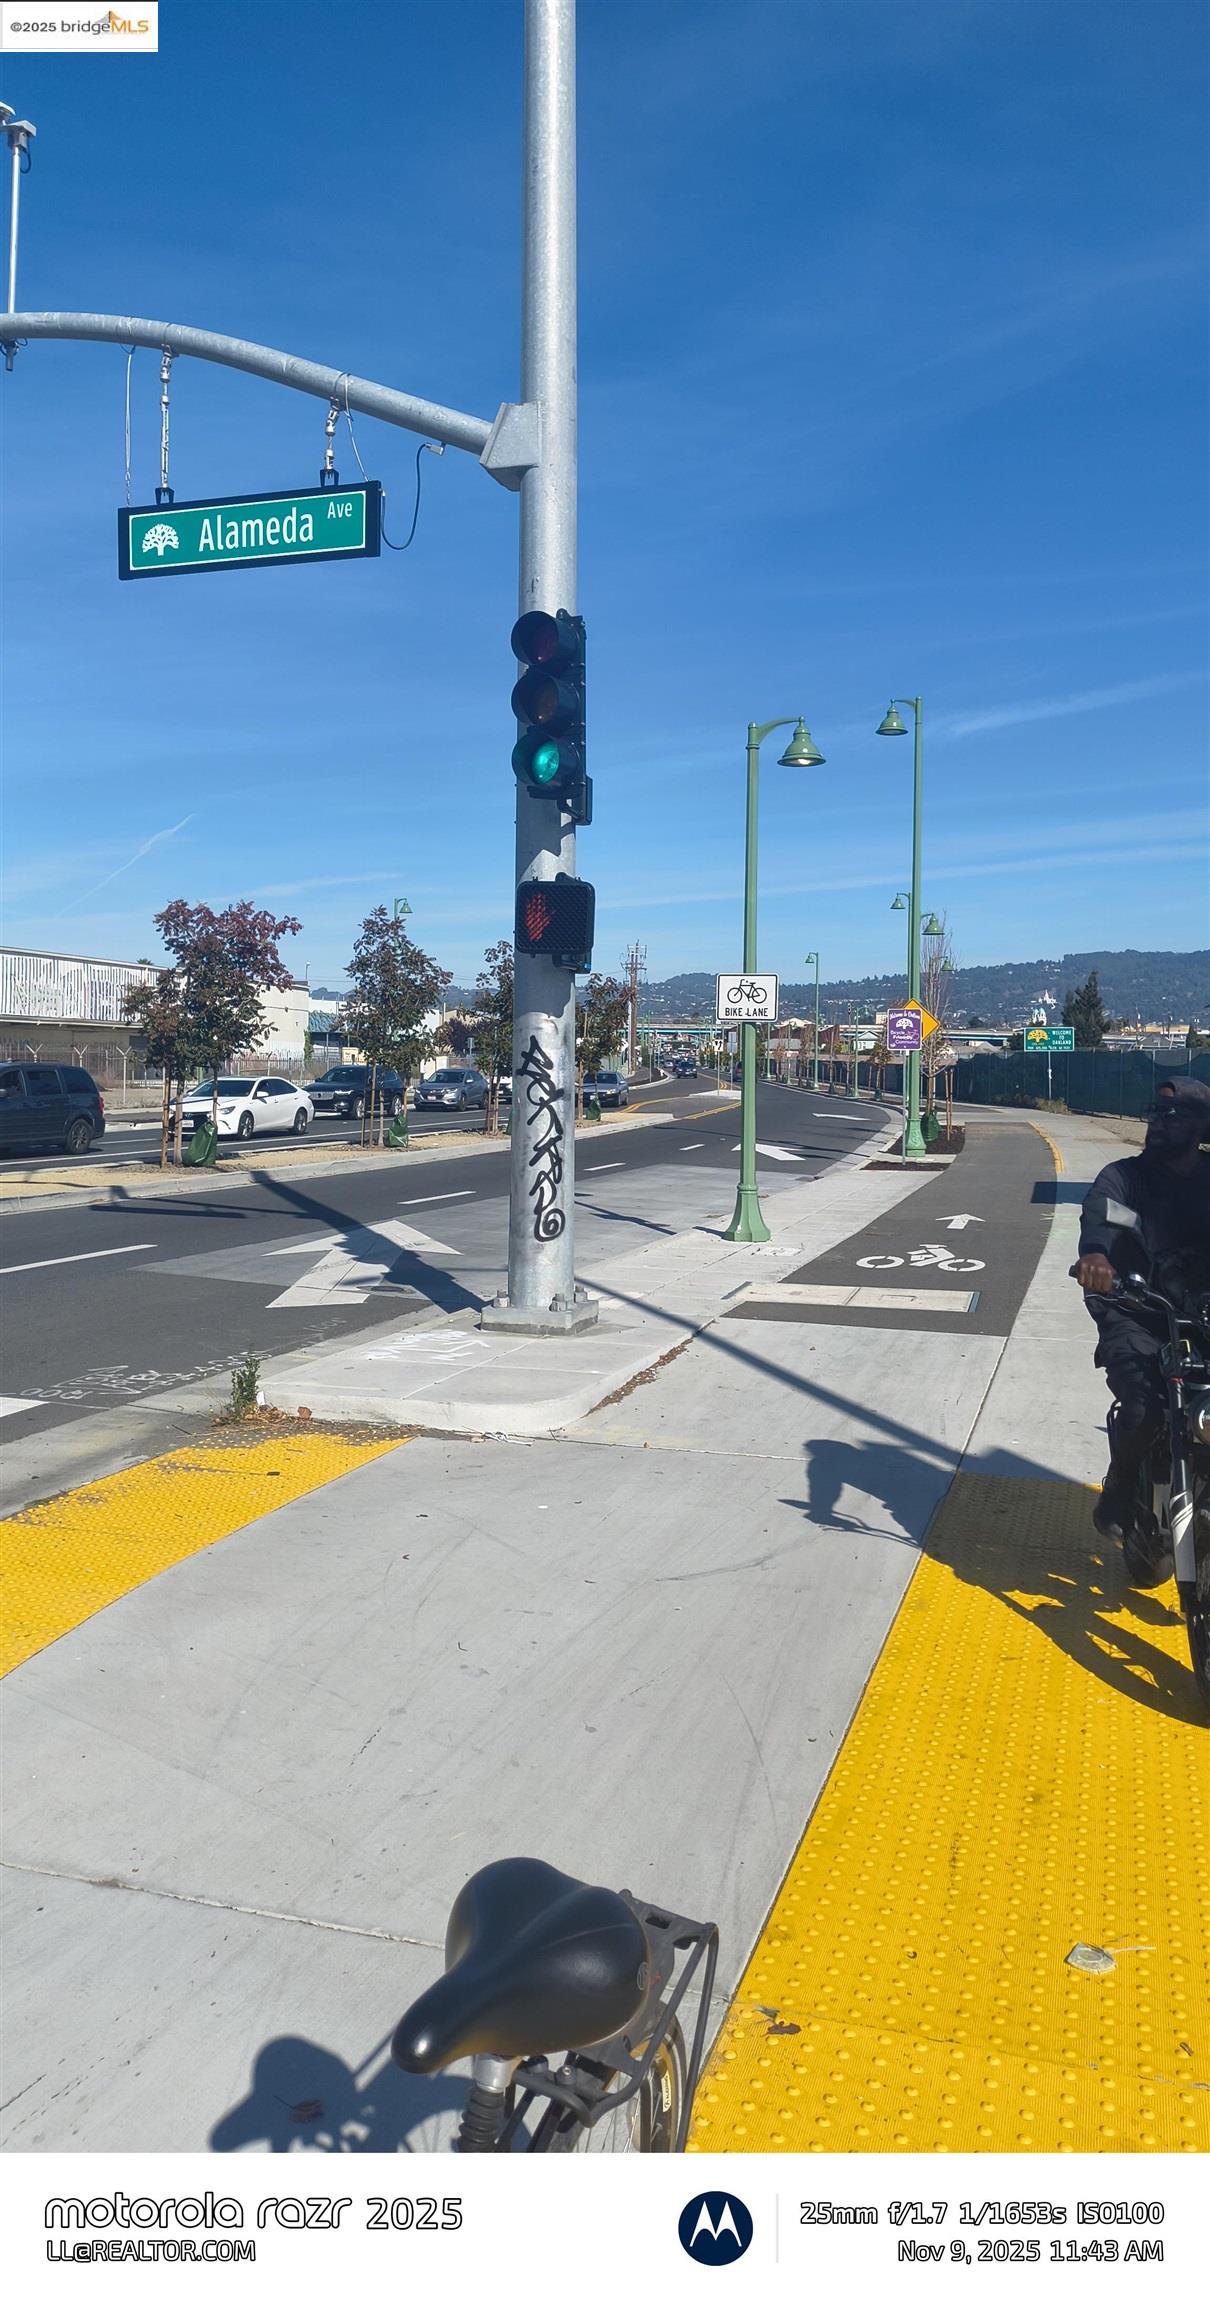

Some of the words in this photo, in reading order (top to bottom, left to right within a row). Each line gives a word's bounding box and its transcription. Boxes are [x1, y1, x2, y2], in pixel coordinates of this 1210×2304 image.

[198, 506, 314, 553] Alameda
[327, 501, 353, 519] Ave
[724, 1007, 743, 1017] BIKE
[746, 1007, 769, 1017] LANE
